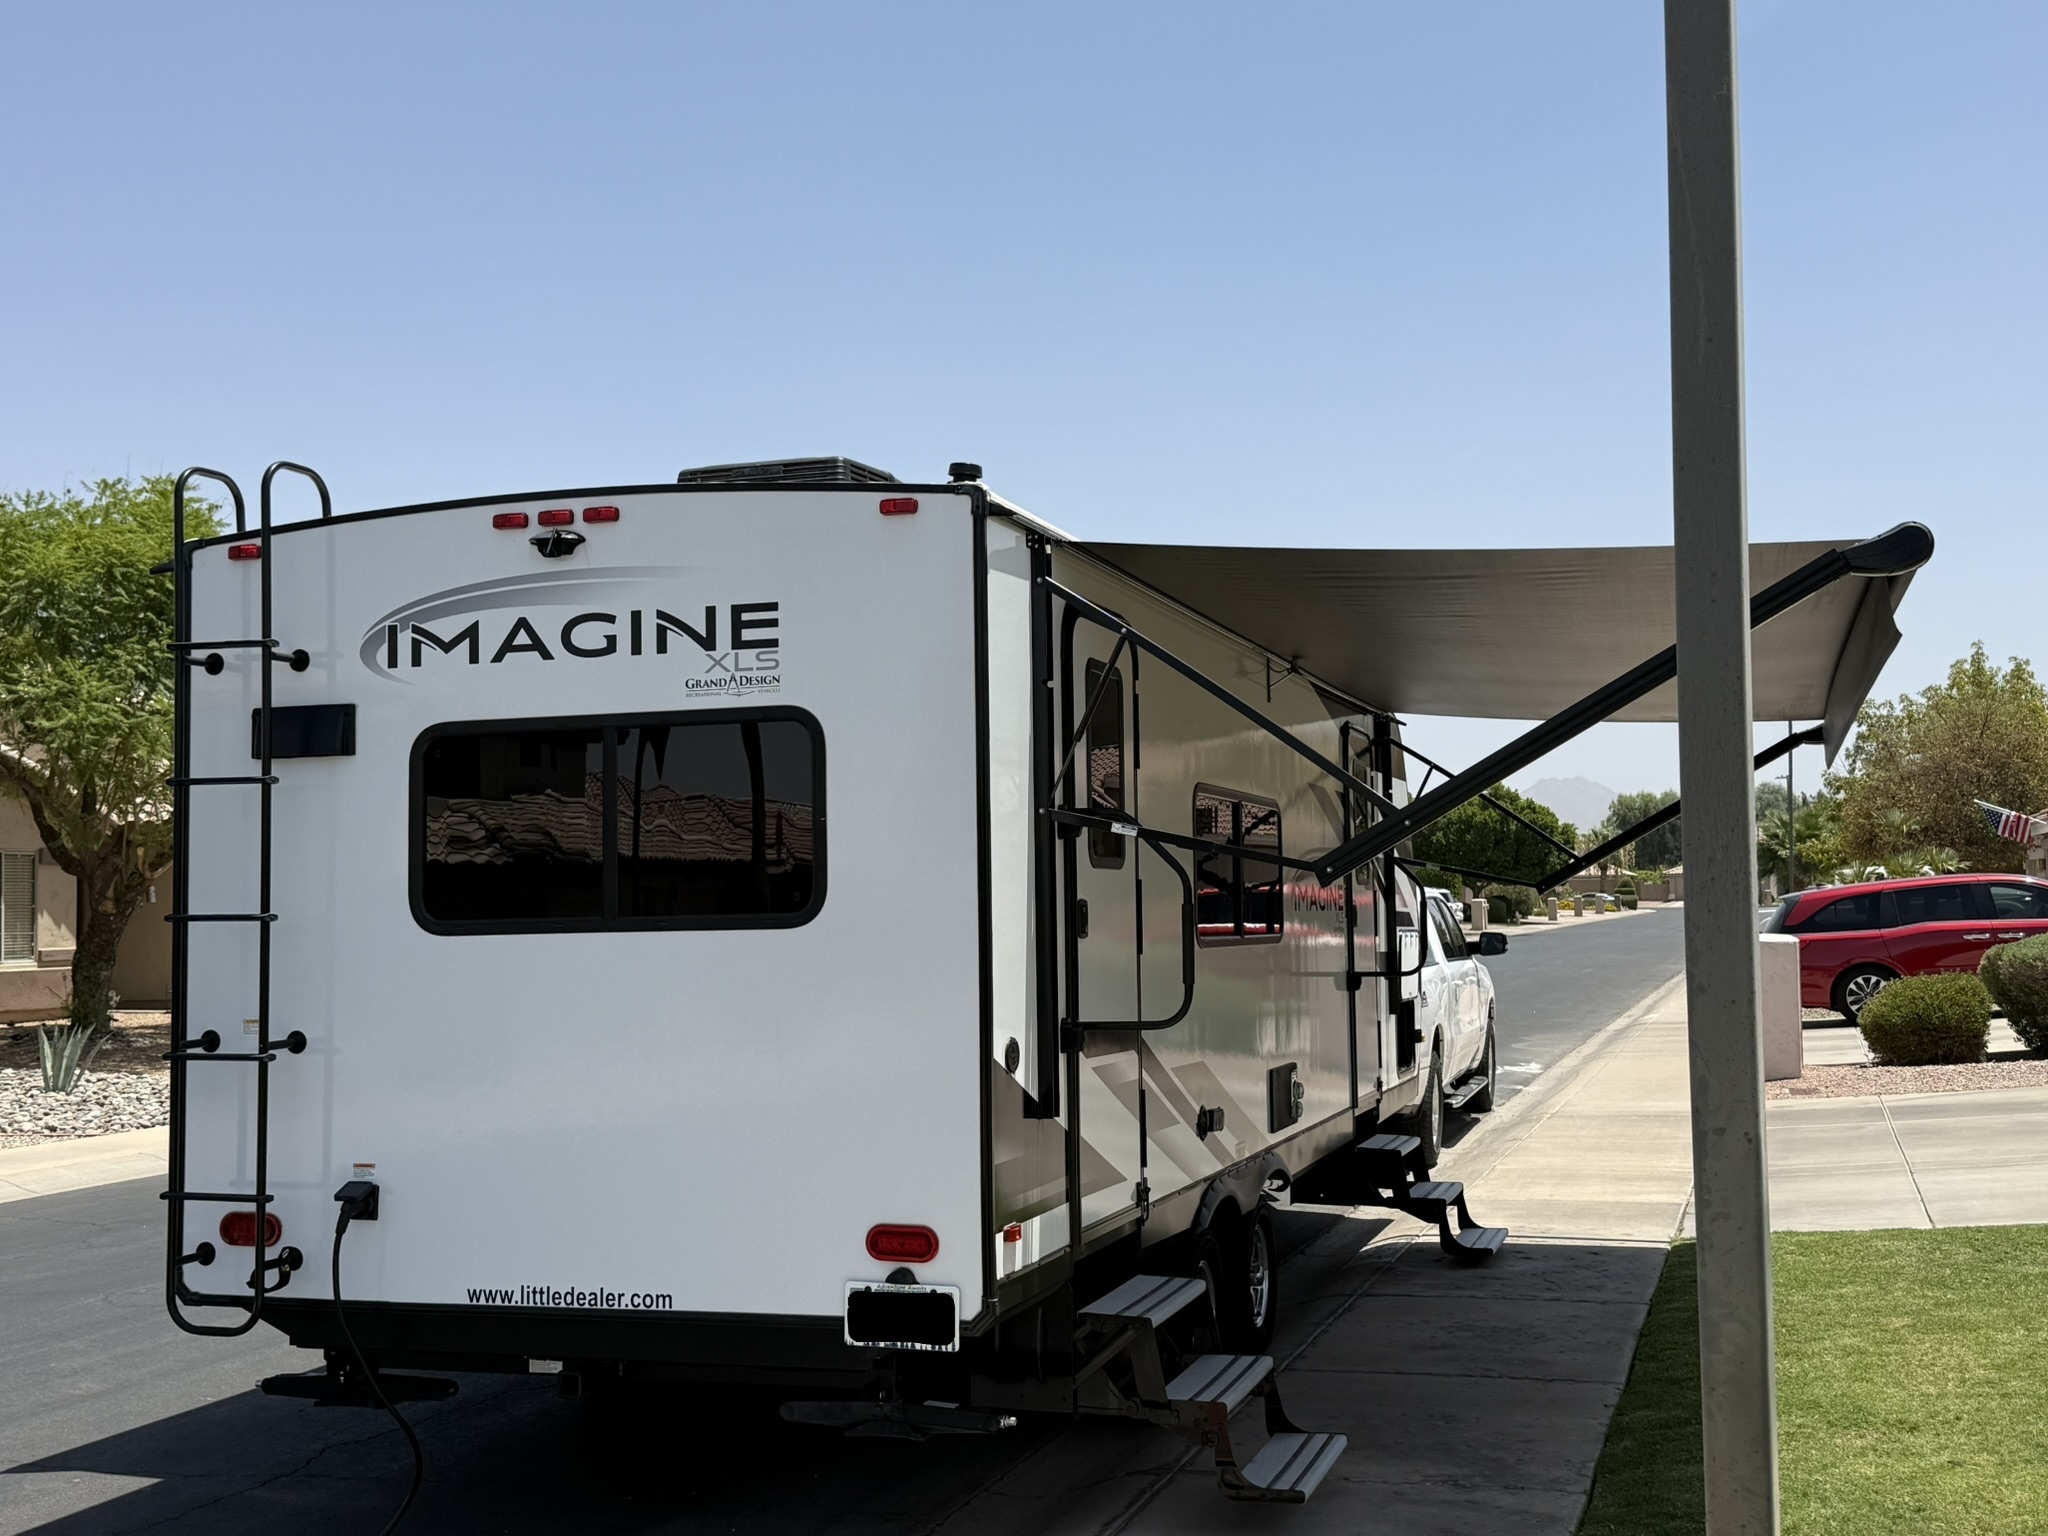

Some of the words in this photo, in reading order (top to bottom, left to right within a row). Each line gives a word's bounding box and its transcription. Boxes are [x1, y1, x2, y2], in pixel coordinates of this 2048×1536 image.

[387, 601, 779, 669] IMAGINE
[704, 650, 780, 673] XLS
[685, 677, 727, 690] GRAND
[739, 674, 781, 687] DESIGN
[467, 1285, 673, 1310] www.littledealer.com
